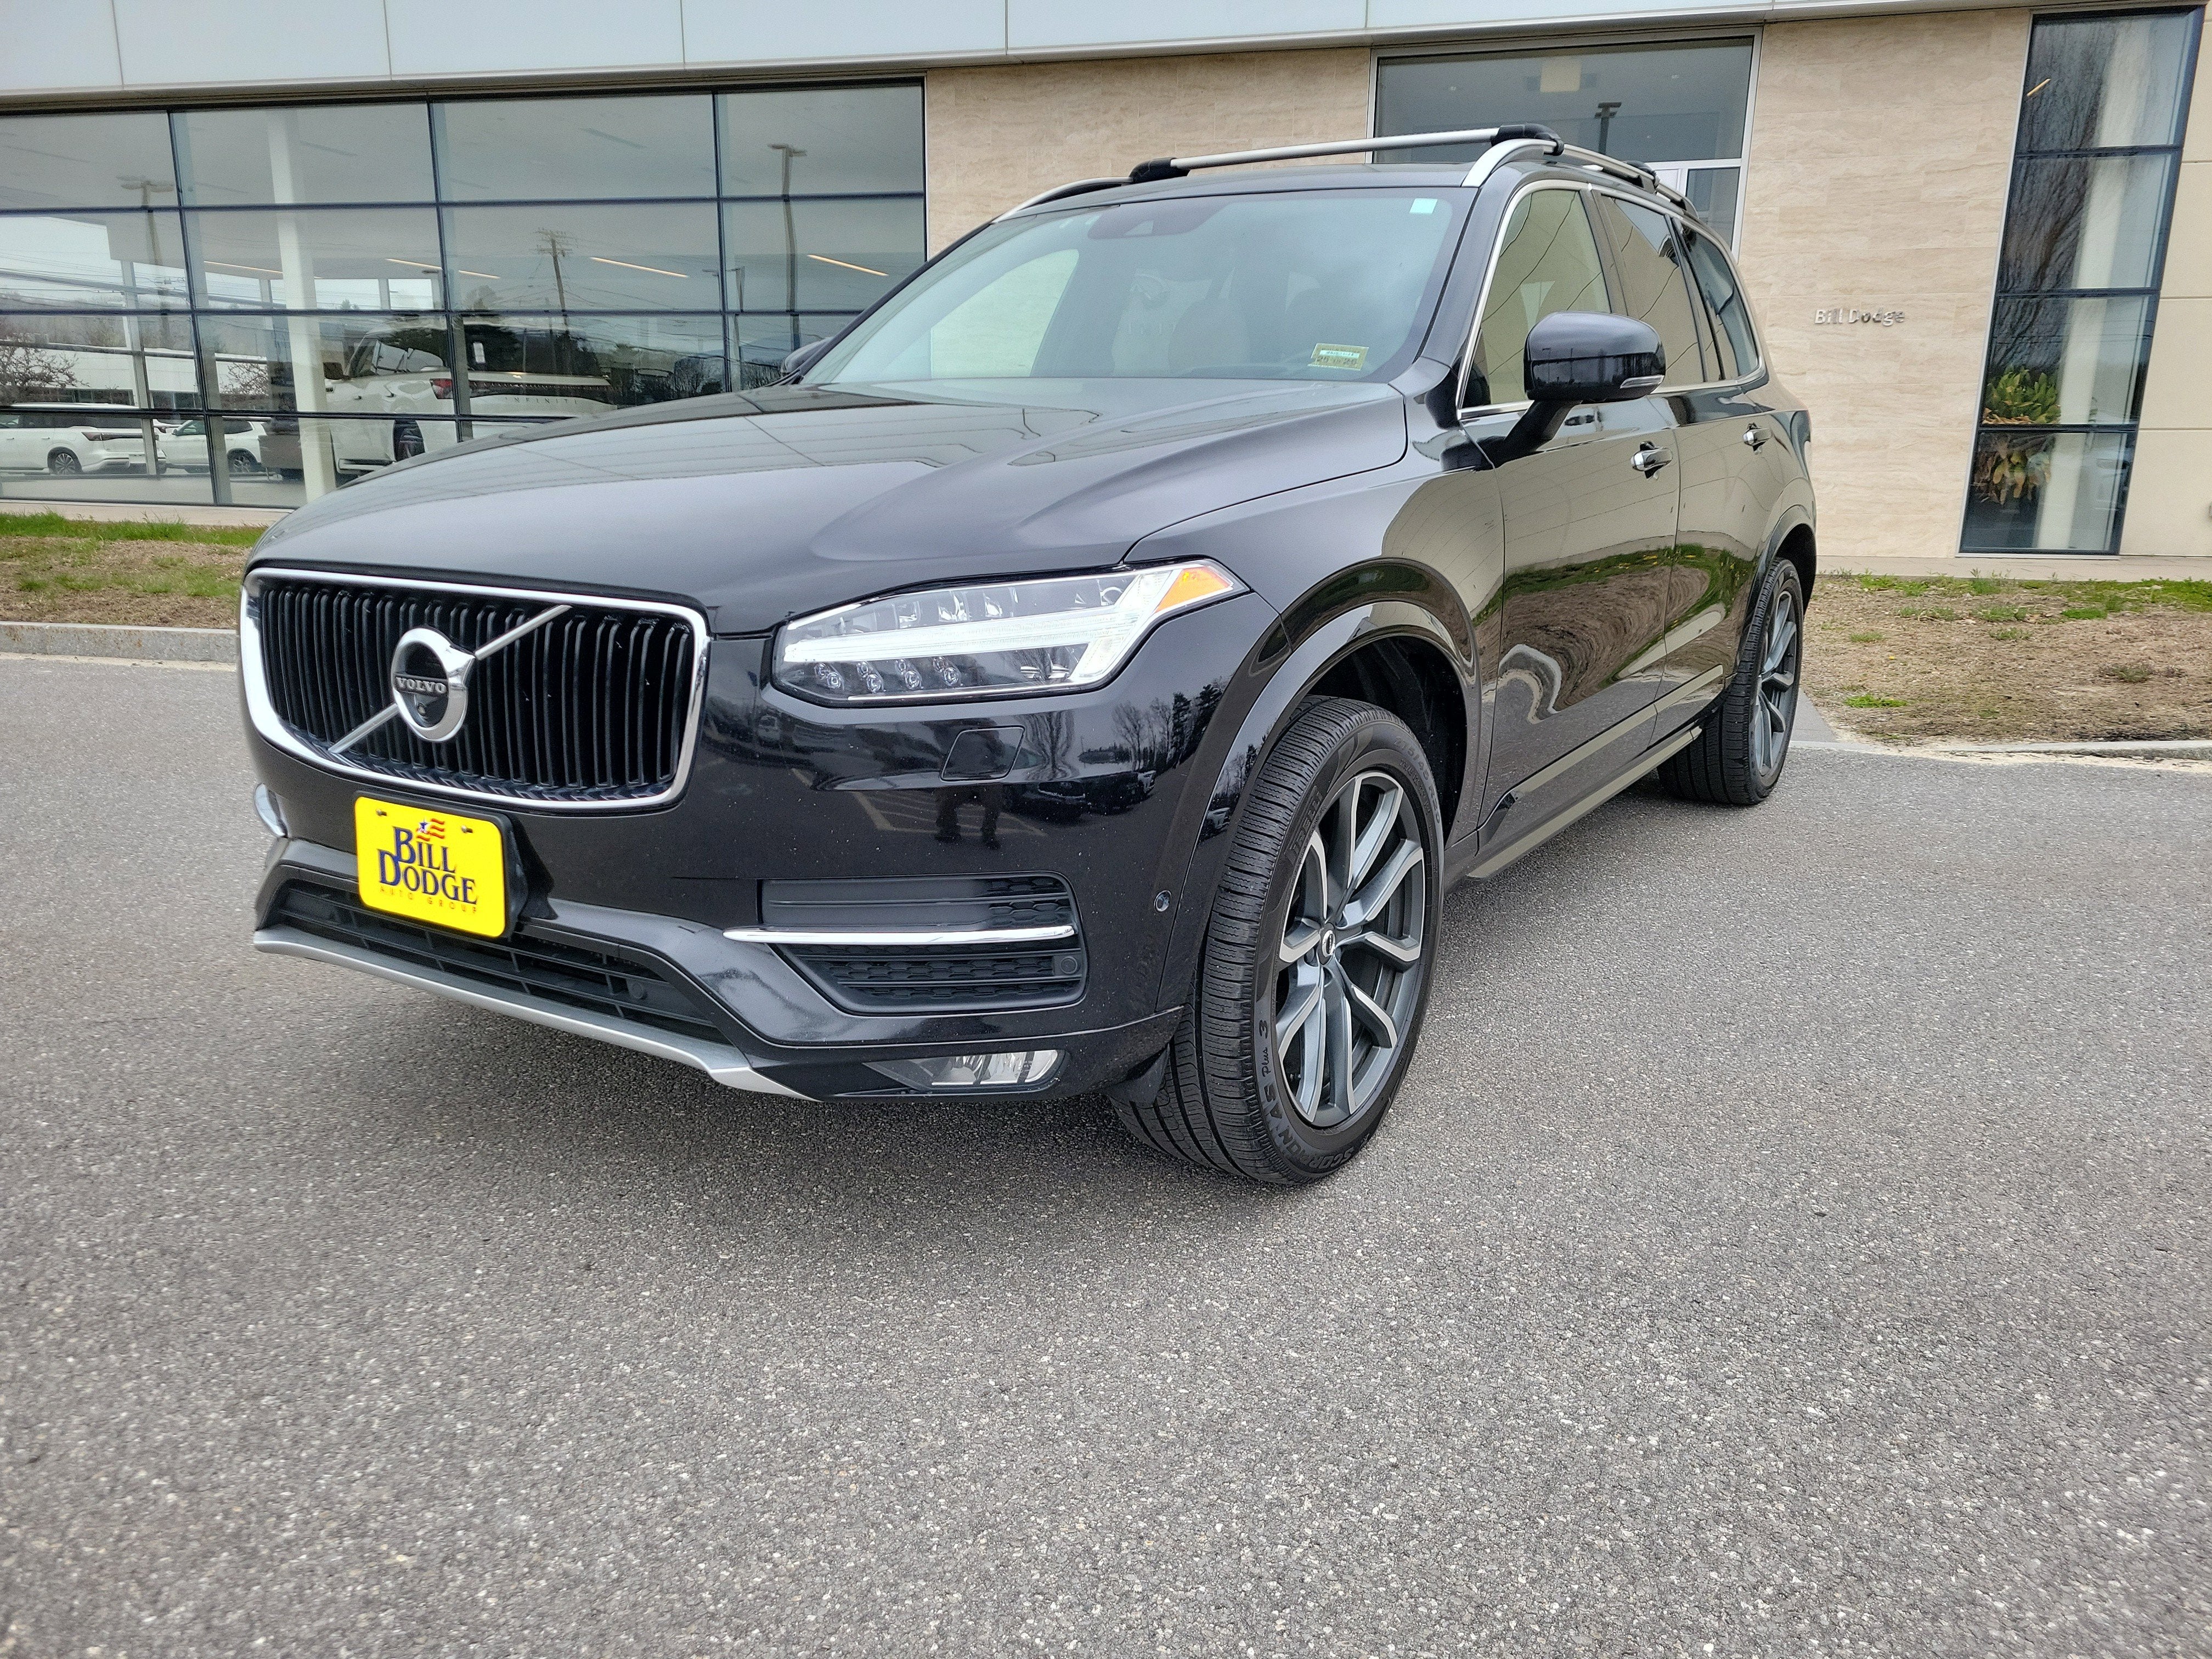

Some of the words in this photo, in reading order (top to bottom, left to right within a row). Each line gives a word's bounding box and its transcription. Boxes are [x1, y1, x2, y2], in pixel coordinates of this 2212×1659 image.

[1815, 308, 1843, 324] Bill
[1848, 307, 1905, 327] Dodge
[395, 676, 448, 694] VOLVO
[392, 826, 456, 873] BILL
[377, 848, 479, 905] DODGE
